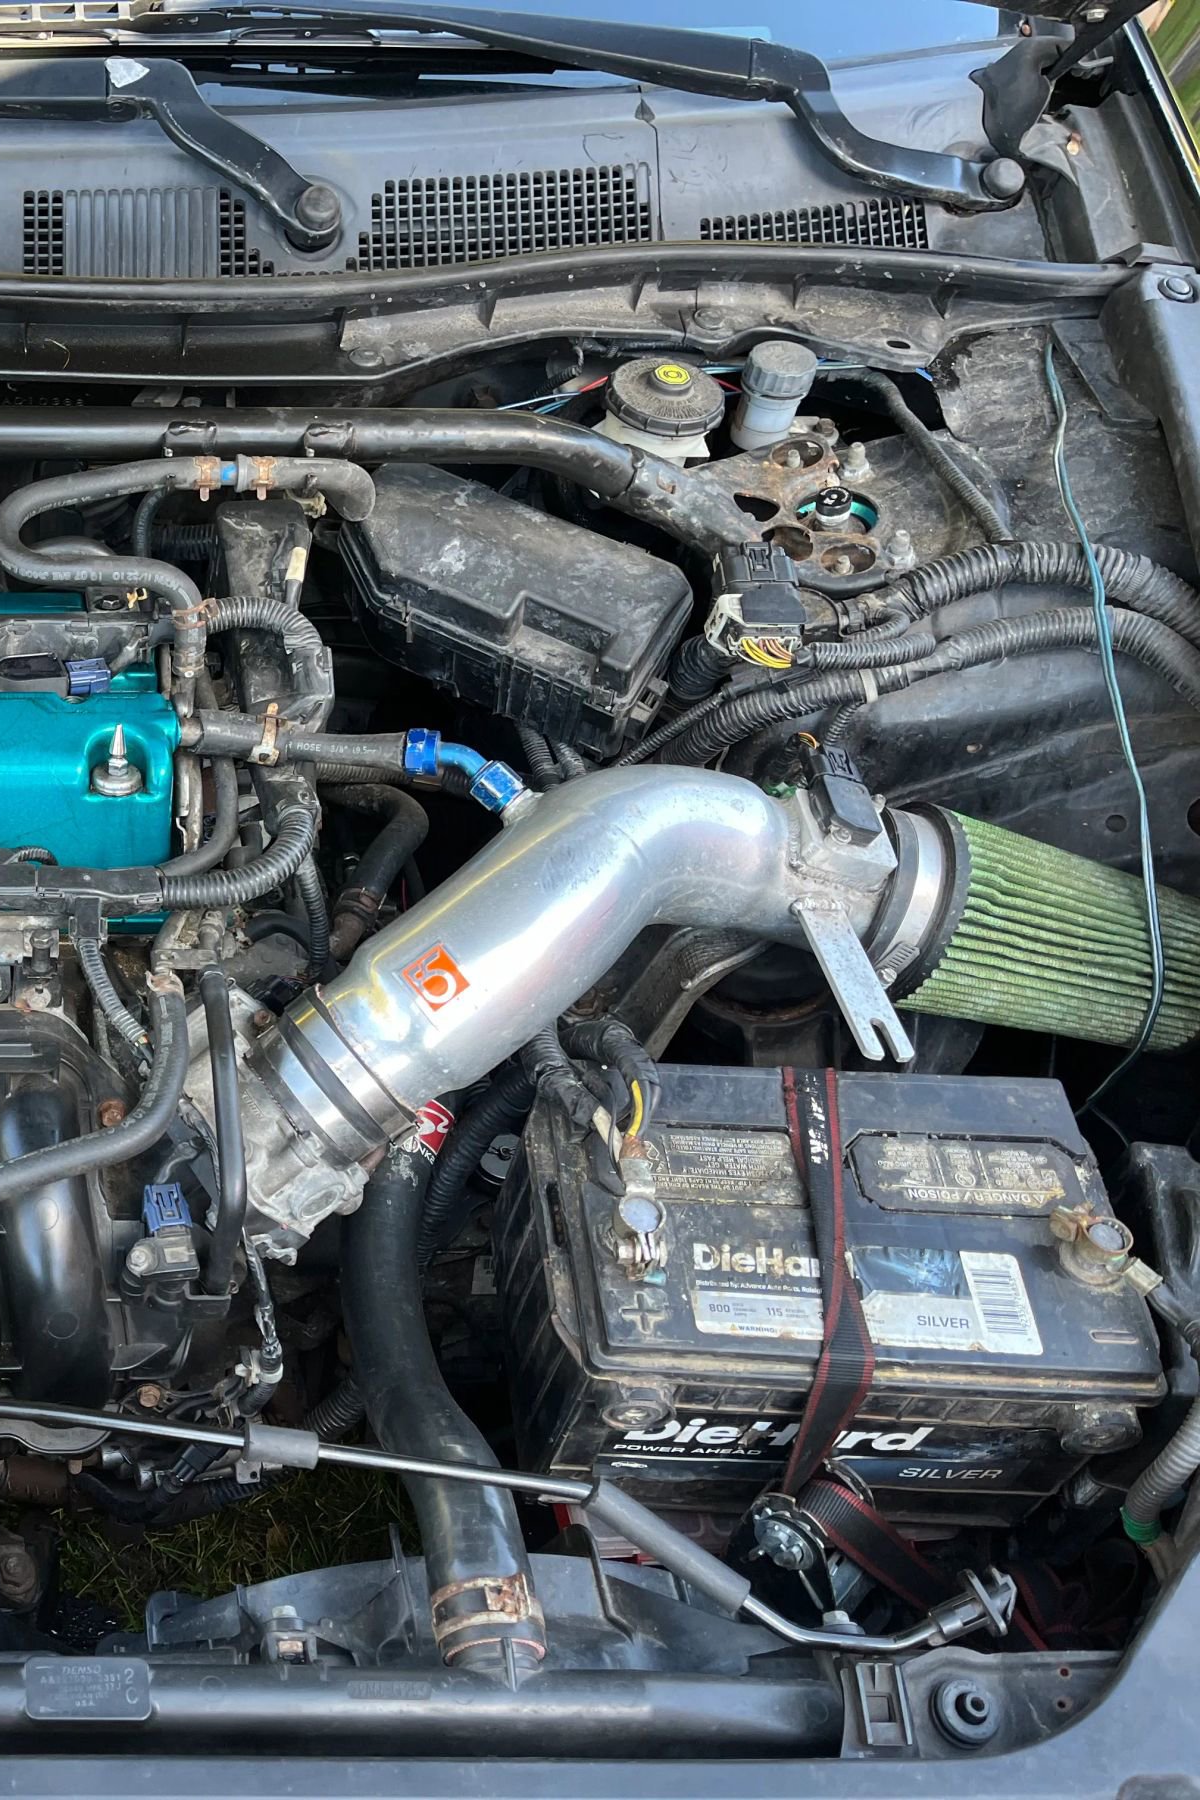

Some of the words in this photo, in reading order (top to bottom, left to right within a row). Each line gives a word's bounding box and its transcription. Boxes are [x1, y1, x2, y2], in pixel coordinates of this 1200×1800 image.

[296, 742, 322, 752] HOSE
[907, 1189, 960, 1201] POISON
[973, 1191, 1031, 1203] DANGER
[709, 1303, 730, 1313] 800
[766, 1307, 783, 1317] 115
[916, 1315, 970, 1329] SILVER
[613, 1443, 686, 1454] POWER
[690, 1447, 762, 1456] AHEAD
[899, 1467, 1003, 1480] SILVER
[62, 1665, 101, 1675] DENSO
[124, 1668, 134, 1684] 2
